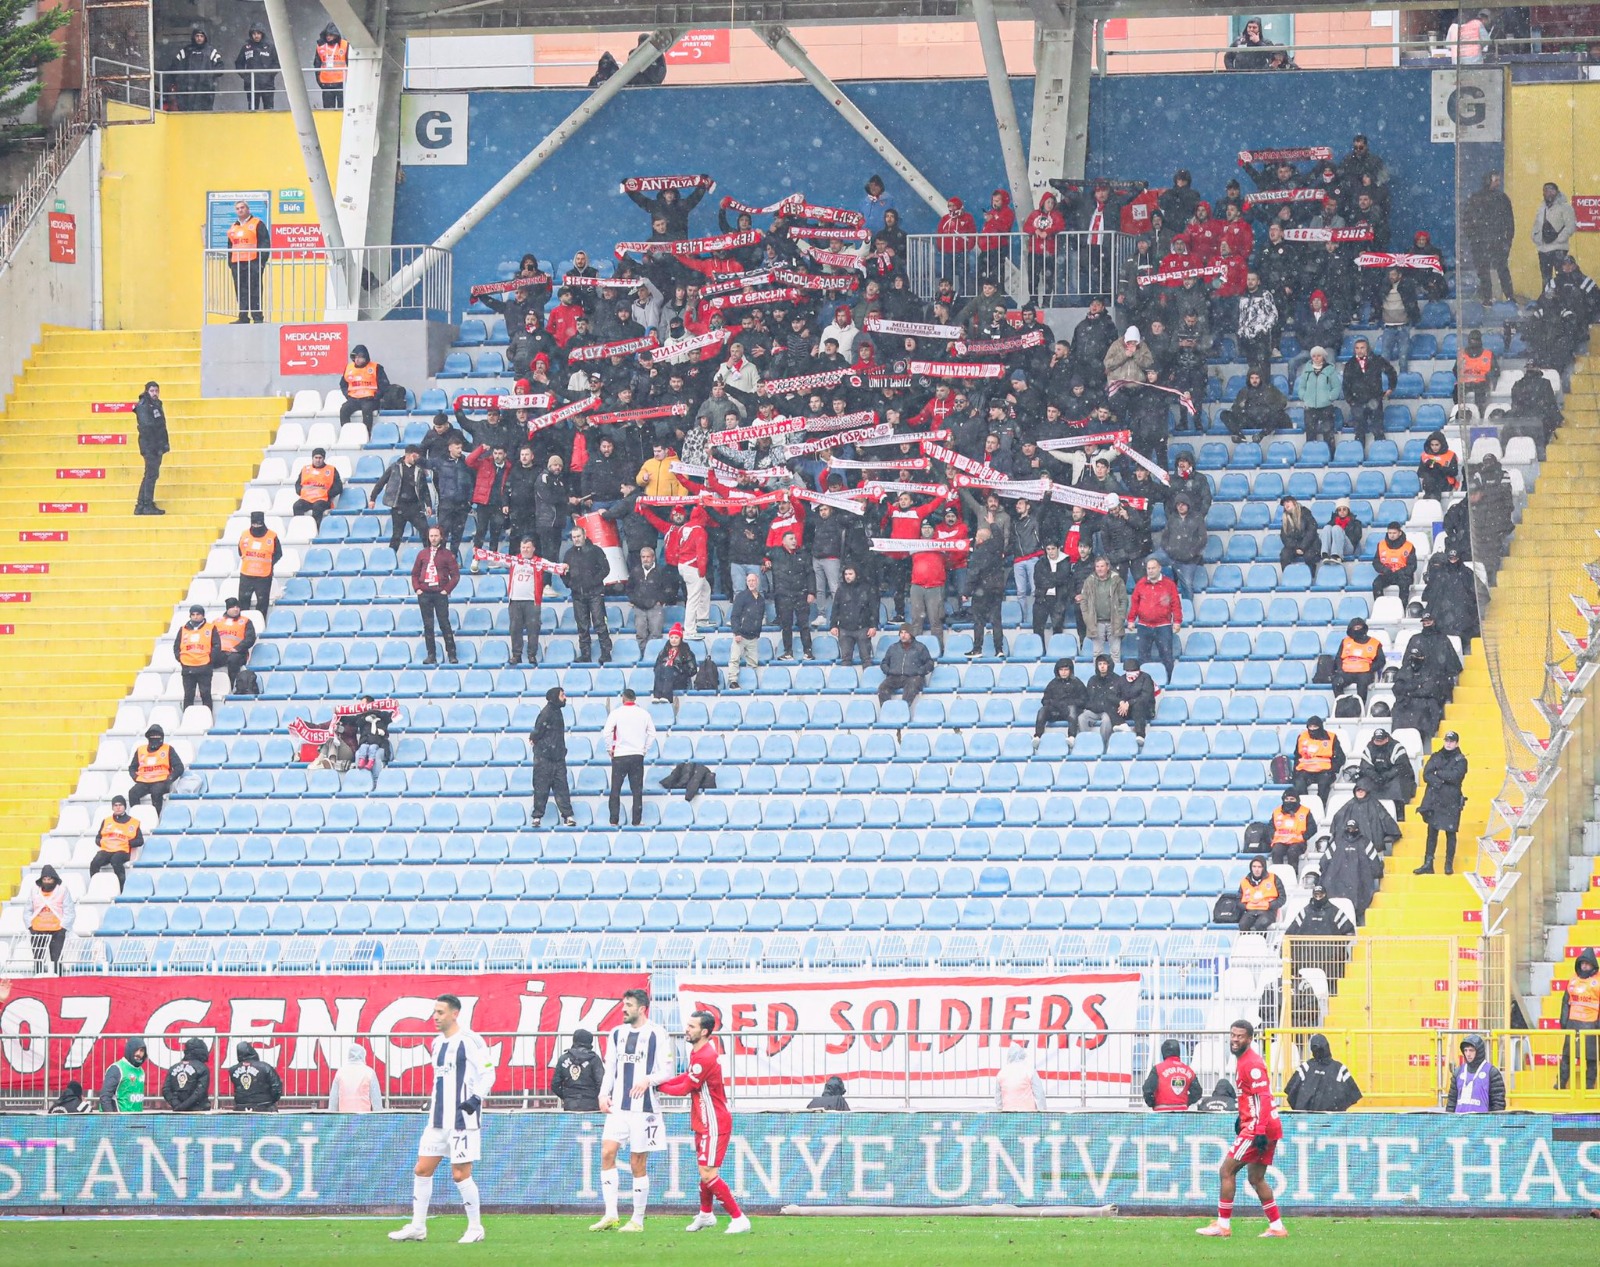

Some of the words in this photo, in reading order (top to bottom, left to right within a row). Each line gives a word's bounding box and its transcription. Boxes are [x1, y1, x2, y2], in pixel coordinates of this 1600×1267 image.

[1446, 85, 1486, 126] G
[415, 111, 452, 149] G
[641, 179, 693, 191] ANTALYA
[280, 190, 298, 198] EXIT
[283, 203, 301, 212] Büfe
[275, 225, 322, 235] MEDICALPA
[729, 294, 742, 305] 07
[285, 331, 342, 342] MEDICALPARK
[462, 397, 493, 407] SINCE
[724, 423, 791, 441] ANTALYASPOR
[517, 573, 531, 582] 07
[825, 994, 1108, 1054] SOLDIERS
[1, 996, 112, 1073] 07
[1161, 1066, 1177, 1078] SPOR
[644, 1125, 659, 1140] 17
[452, 1134, 468, 1151] 71
[699, 1139, 707, 1153] 4
[576, 1122, 895, 1199] İTNYE
